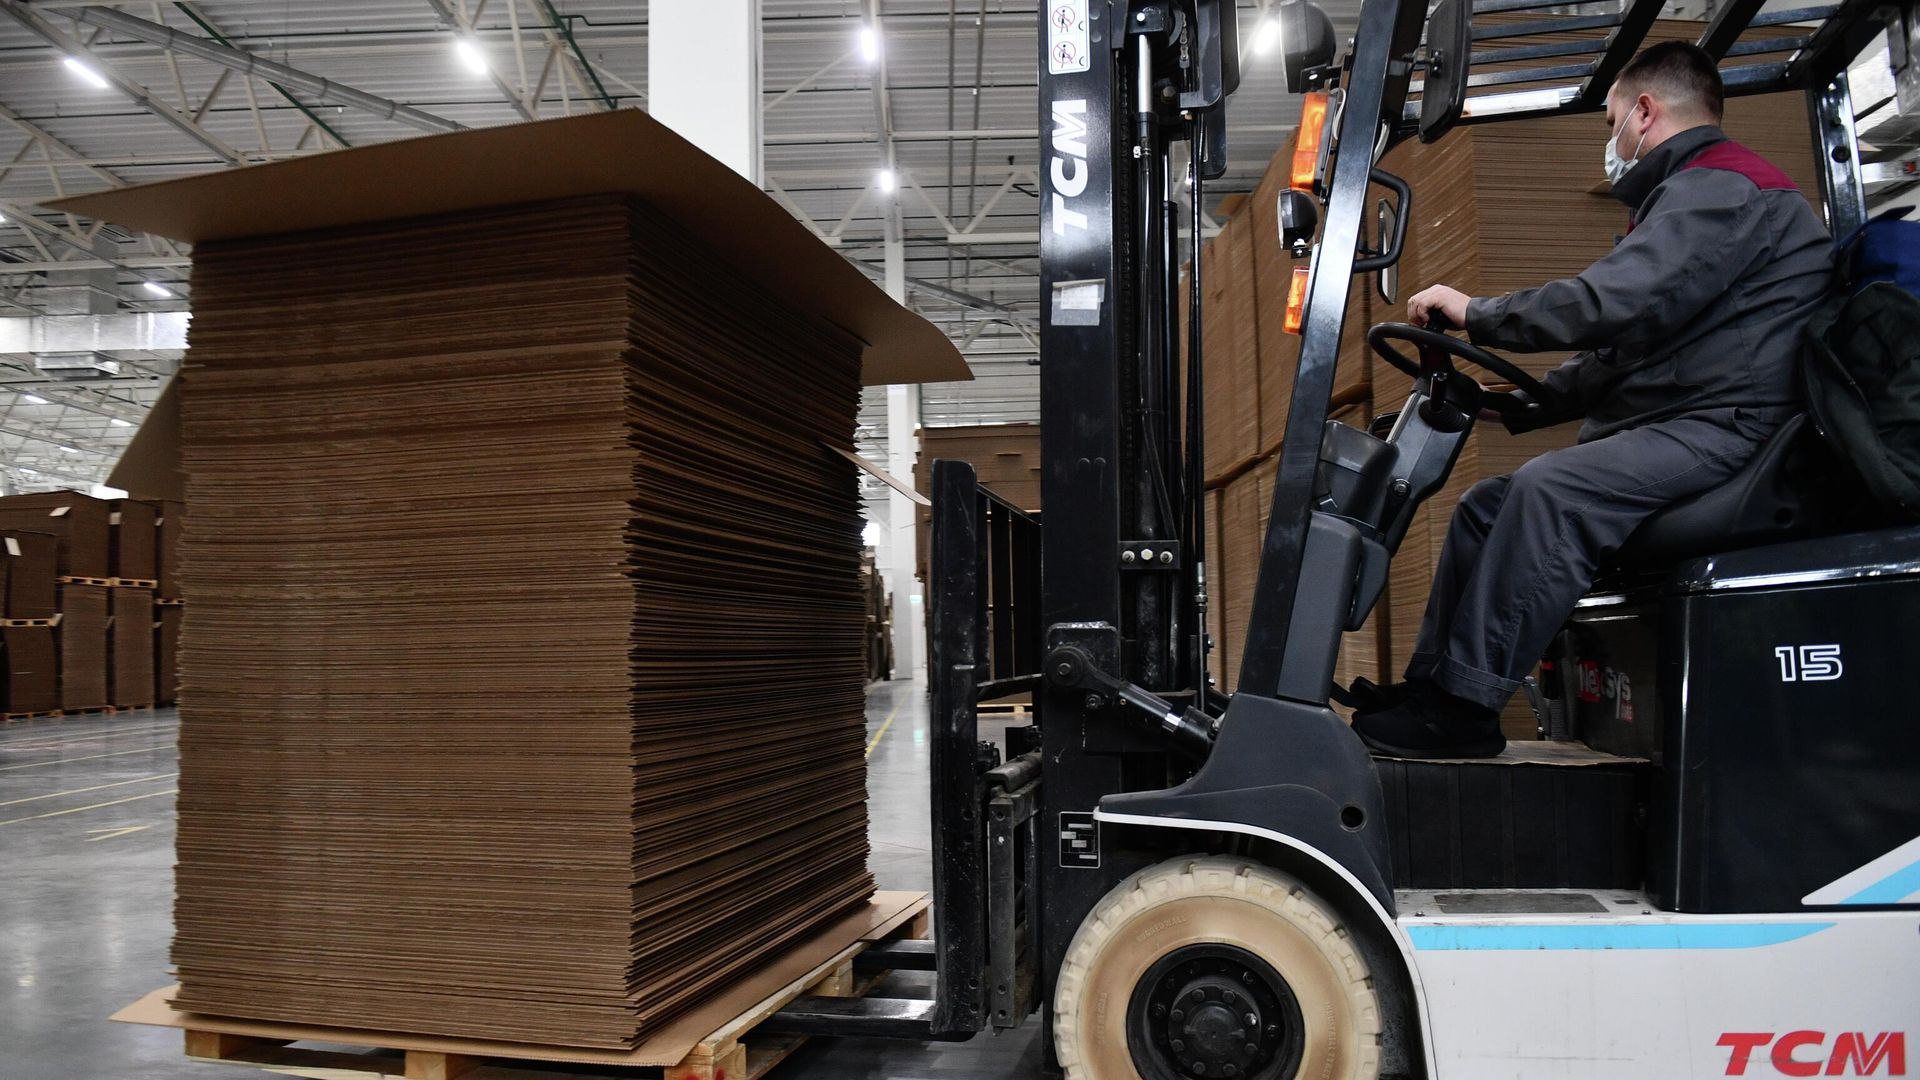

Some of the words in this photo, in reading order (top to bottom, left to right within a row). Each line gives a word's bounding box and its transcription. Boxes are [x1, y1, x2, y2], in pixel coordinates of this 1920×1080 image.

[1050, 99, 1088, 237] TCM
[1775, 644, 1842, 682] 15
[1716, 1030, 1906, 1077] TCM
